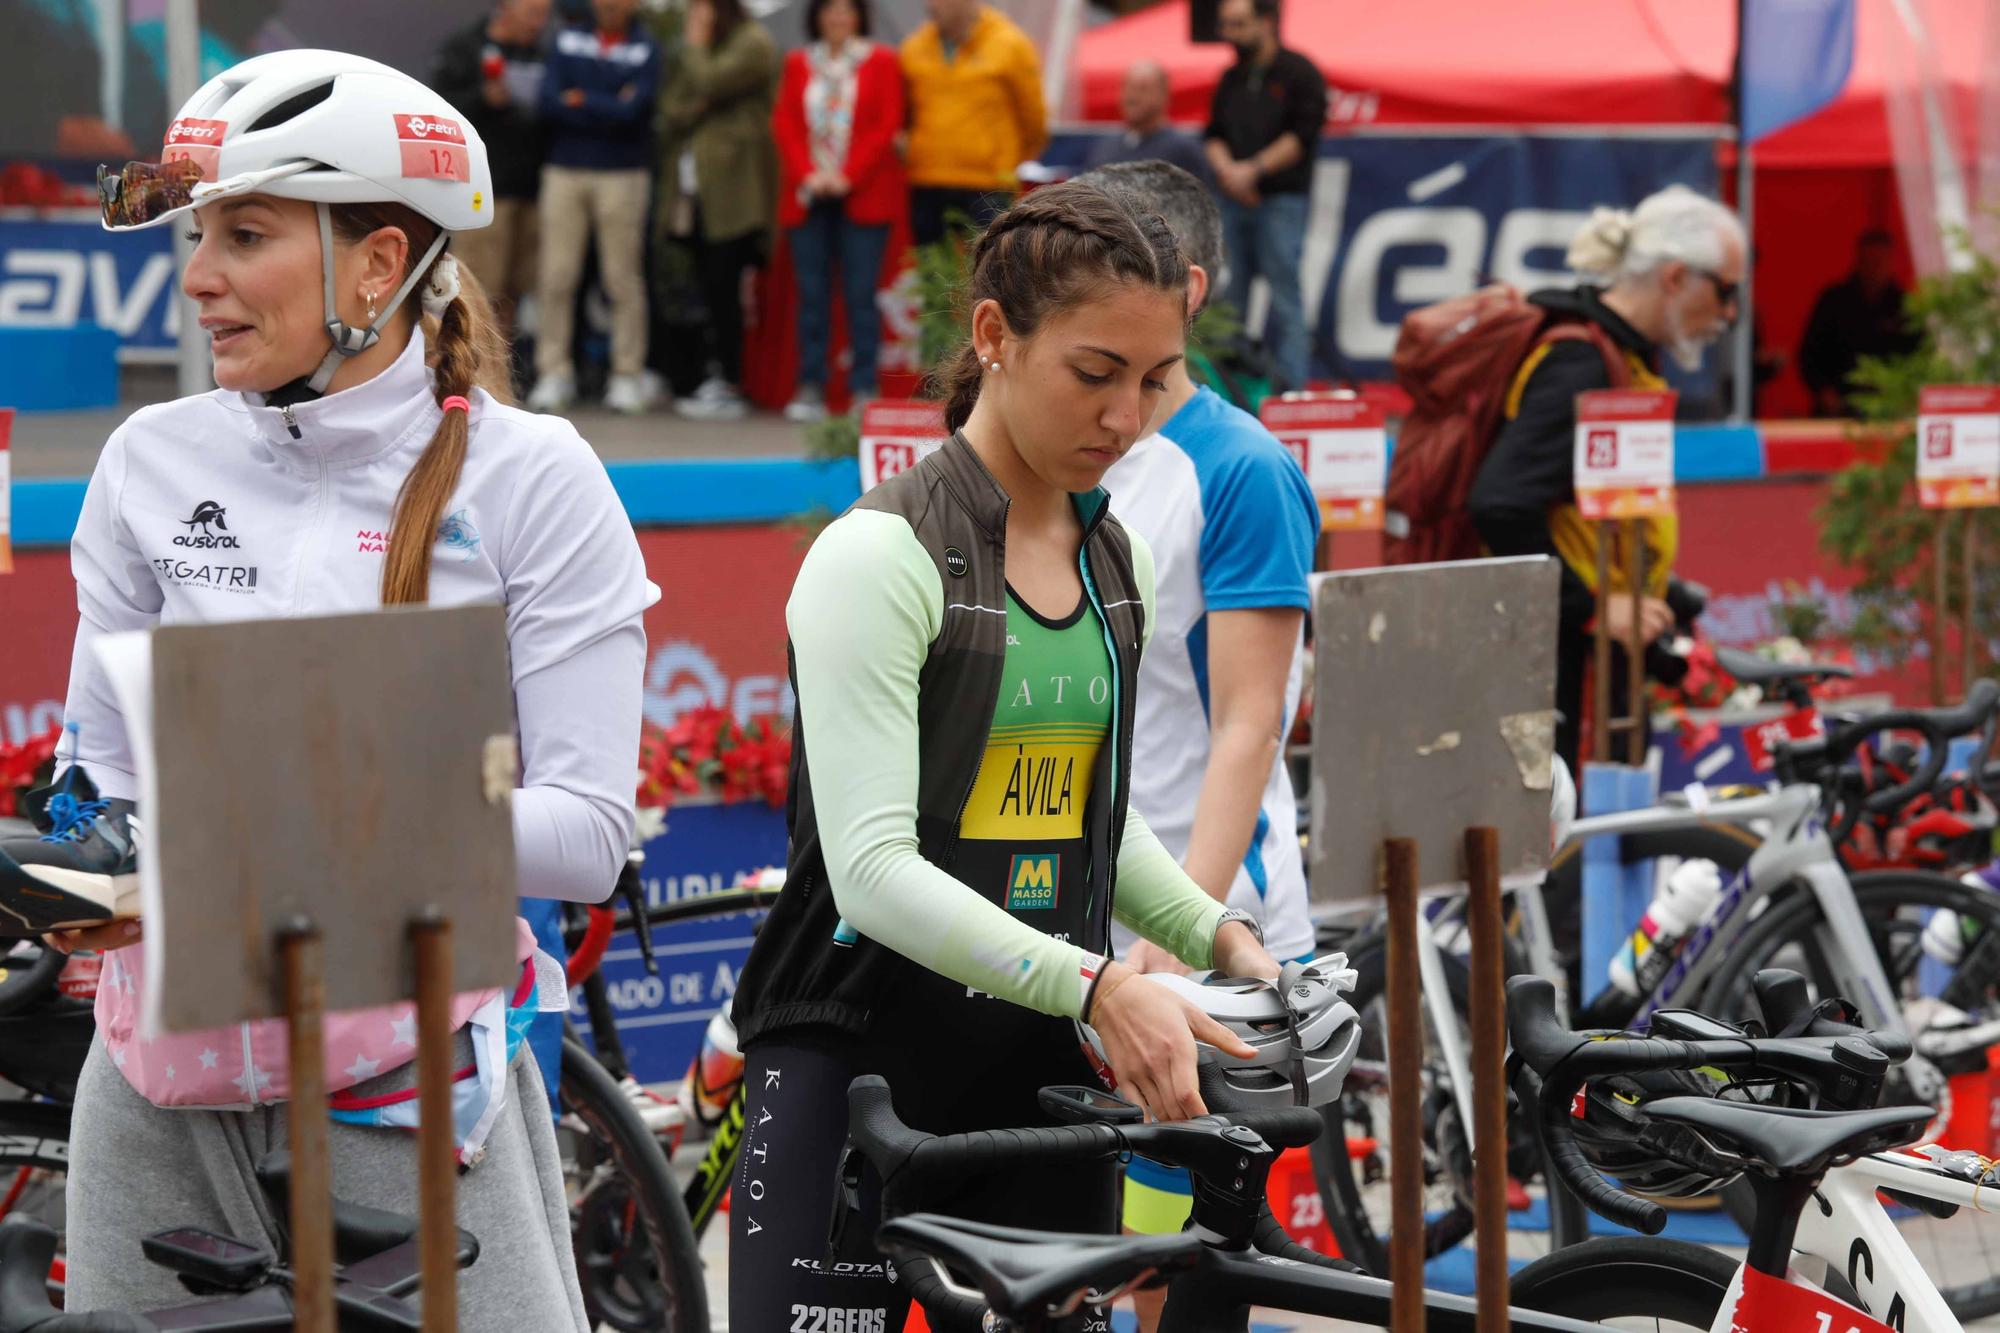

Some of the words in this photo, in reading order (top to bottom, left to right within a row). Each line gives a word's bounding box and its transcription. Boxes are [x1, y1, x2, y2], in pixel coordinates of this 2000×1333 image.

[430, 149, 454, 174] 12
[999, 743, 1074, 816] ÁVILA
[1012, 886, 1053, 899] MASSÓ
[1013, 899, 1050, 908] GARDEN
[746, 1066, 782, 1237] KATOA
[789, 1303, 887, 1333] 226ERS
